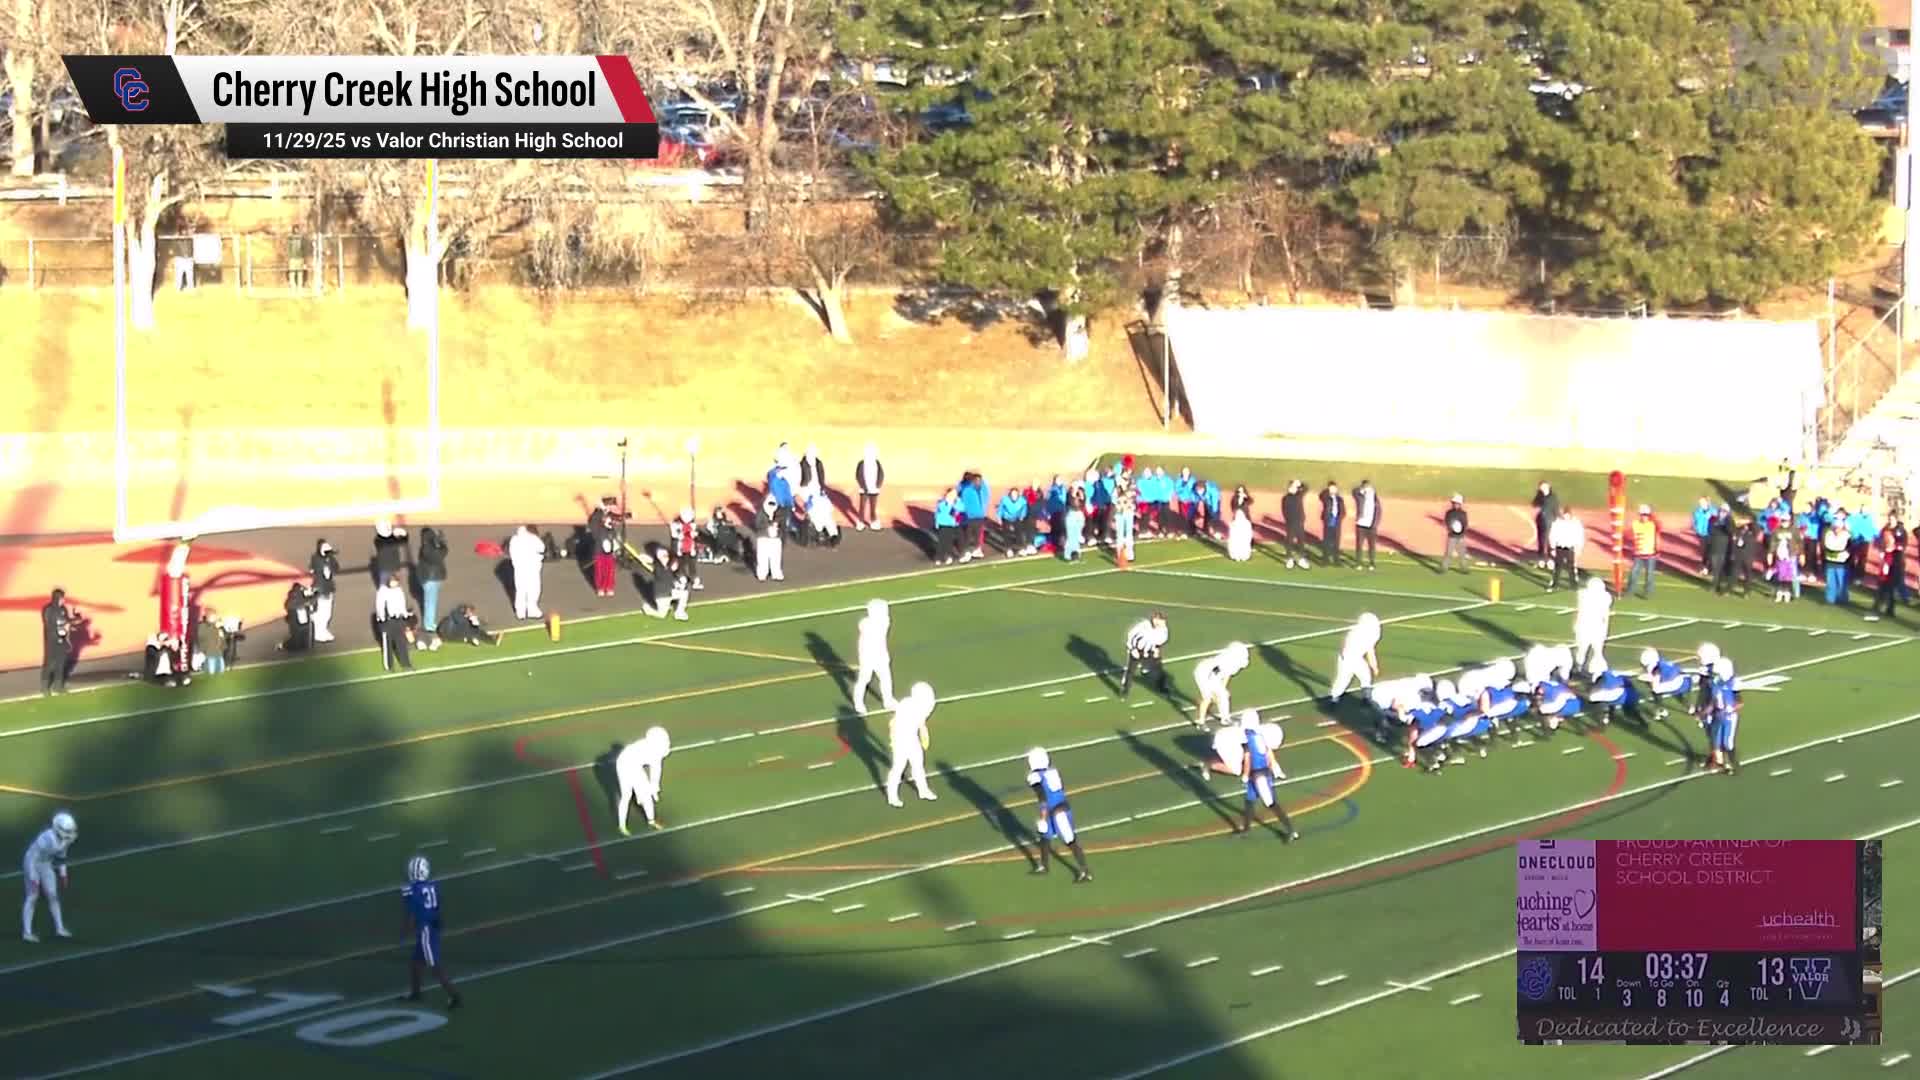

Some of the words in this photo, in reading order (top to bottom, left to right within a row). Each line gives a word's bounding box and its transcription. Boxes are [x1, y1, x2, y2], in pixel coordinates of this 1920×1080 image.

[1519, 856, 1595, 869] ONECLOUD
[1616, 853, 1683, 867] CHERRY
[1689, 853, 1744, 867] CREEK
[1616, 870, 1691, 885] SCHOOL
[1697, 870, 1774, 885] DISTRICT
[422, 886, 438, 909] 31
[1517, 891, 1573, 916] uching
[1762, 909, 1835, 926] uchealth
[1577, 957, 1605, 985] 14
[1646, 953, 1709, 980] 03:37
[1757, 957, 1785, 985] 13
[1616, 980, 1641, 988] Down
[1792, 972, 1830, 983] VALOR
[1558, 986, 1576, 1000] TOL
[1595, 987, 1601, 1000] 1
[1623, 989, 1632, 1007] 3
[1657, 989, 1667, 1007] 8
[1686, 989, 1703, 1007] 10
[1720, 989, 1730, 1007] 4
[1750, 988, 1769, 1001] TOL
[1787, 988, 1792, 1001] 1
[194, 982, 449, 1047] 10
[1536, 1017, 1665, 1037] Dedicated
[1667, 1019, 1691, 1036] to
[1698, 1017, 1824, 1037] Excellence
